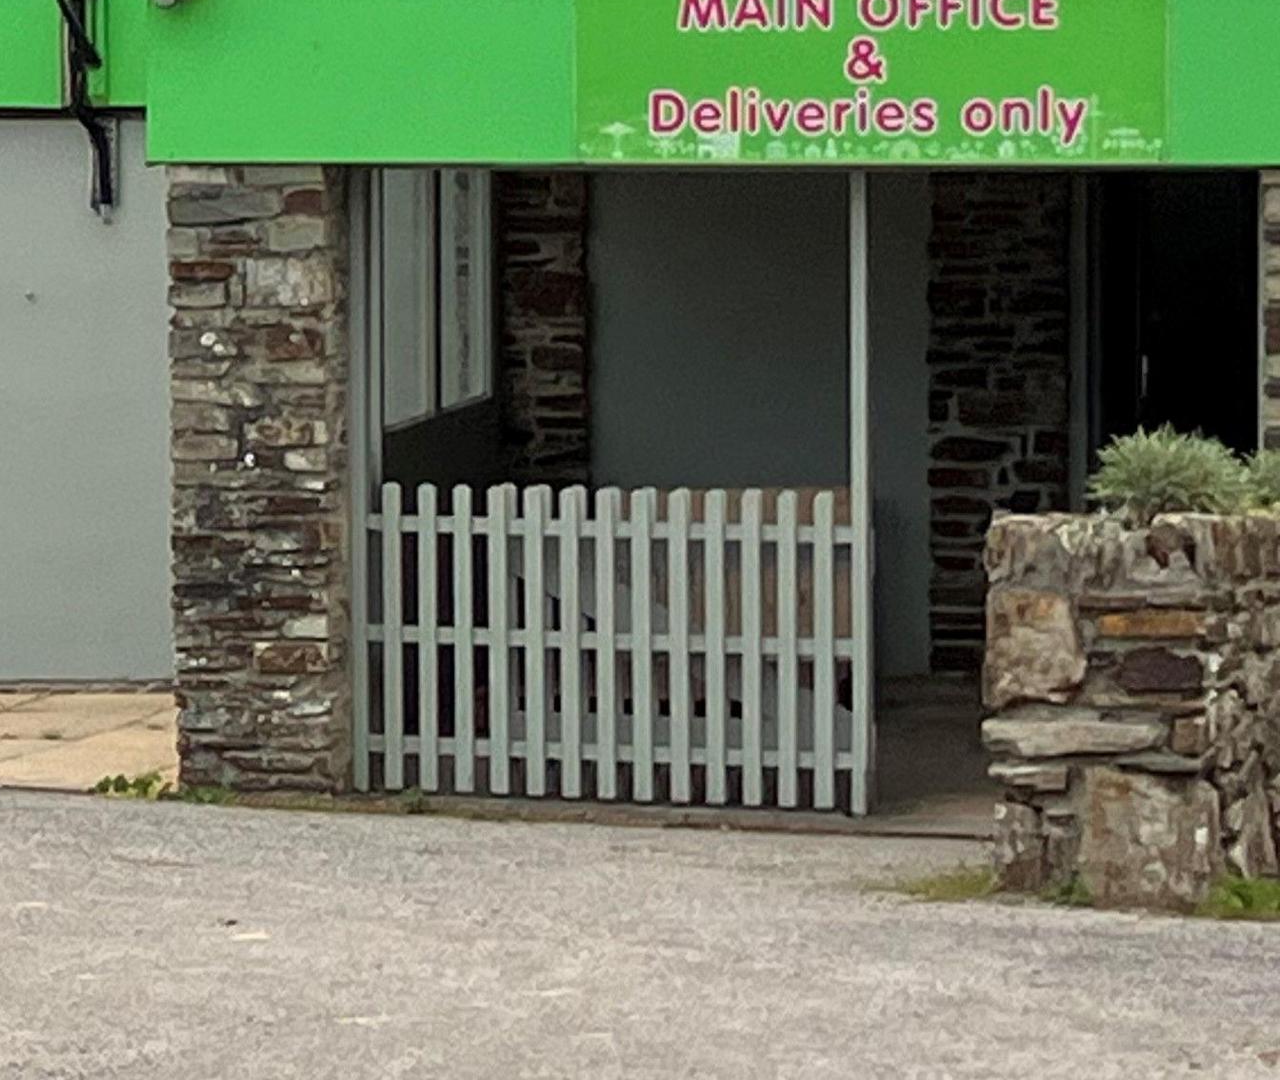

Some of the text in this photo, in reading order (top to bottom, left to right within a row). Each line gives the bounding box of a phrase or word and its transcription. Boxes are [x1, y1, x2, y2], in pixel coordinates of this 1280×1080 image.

[844, 37, 886, 83] &
[648, 86, 1089, 150] Deliveries only
